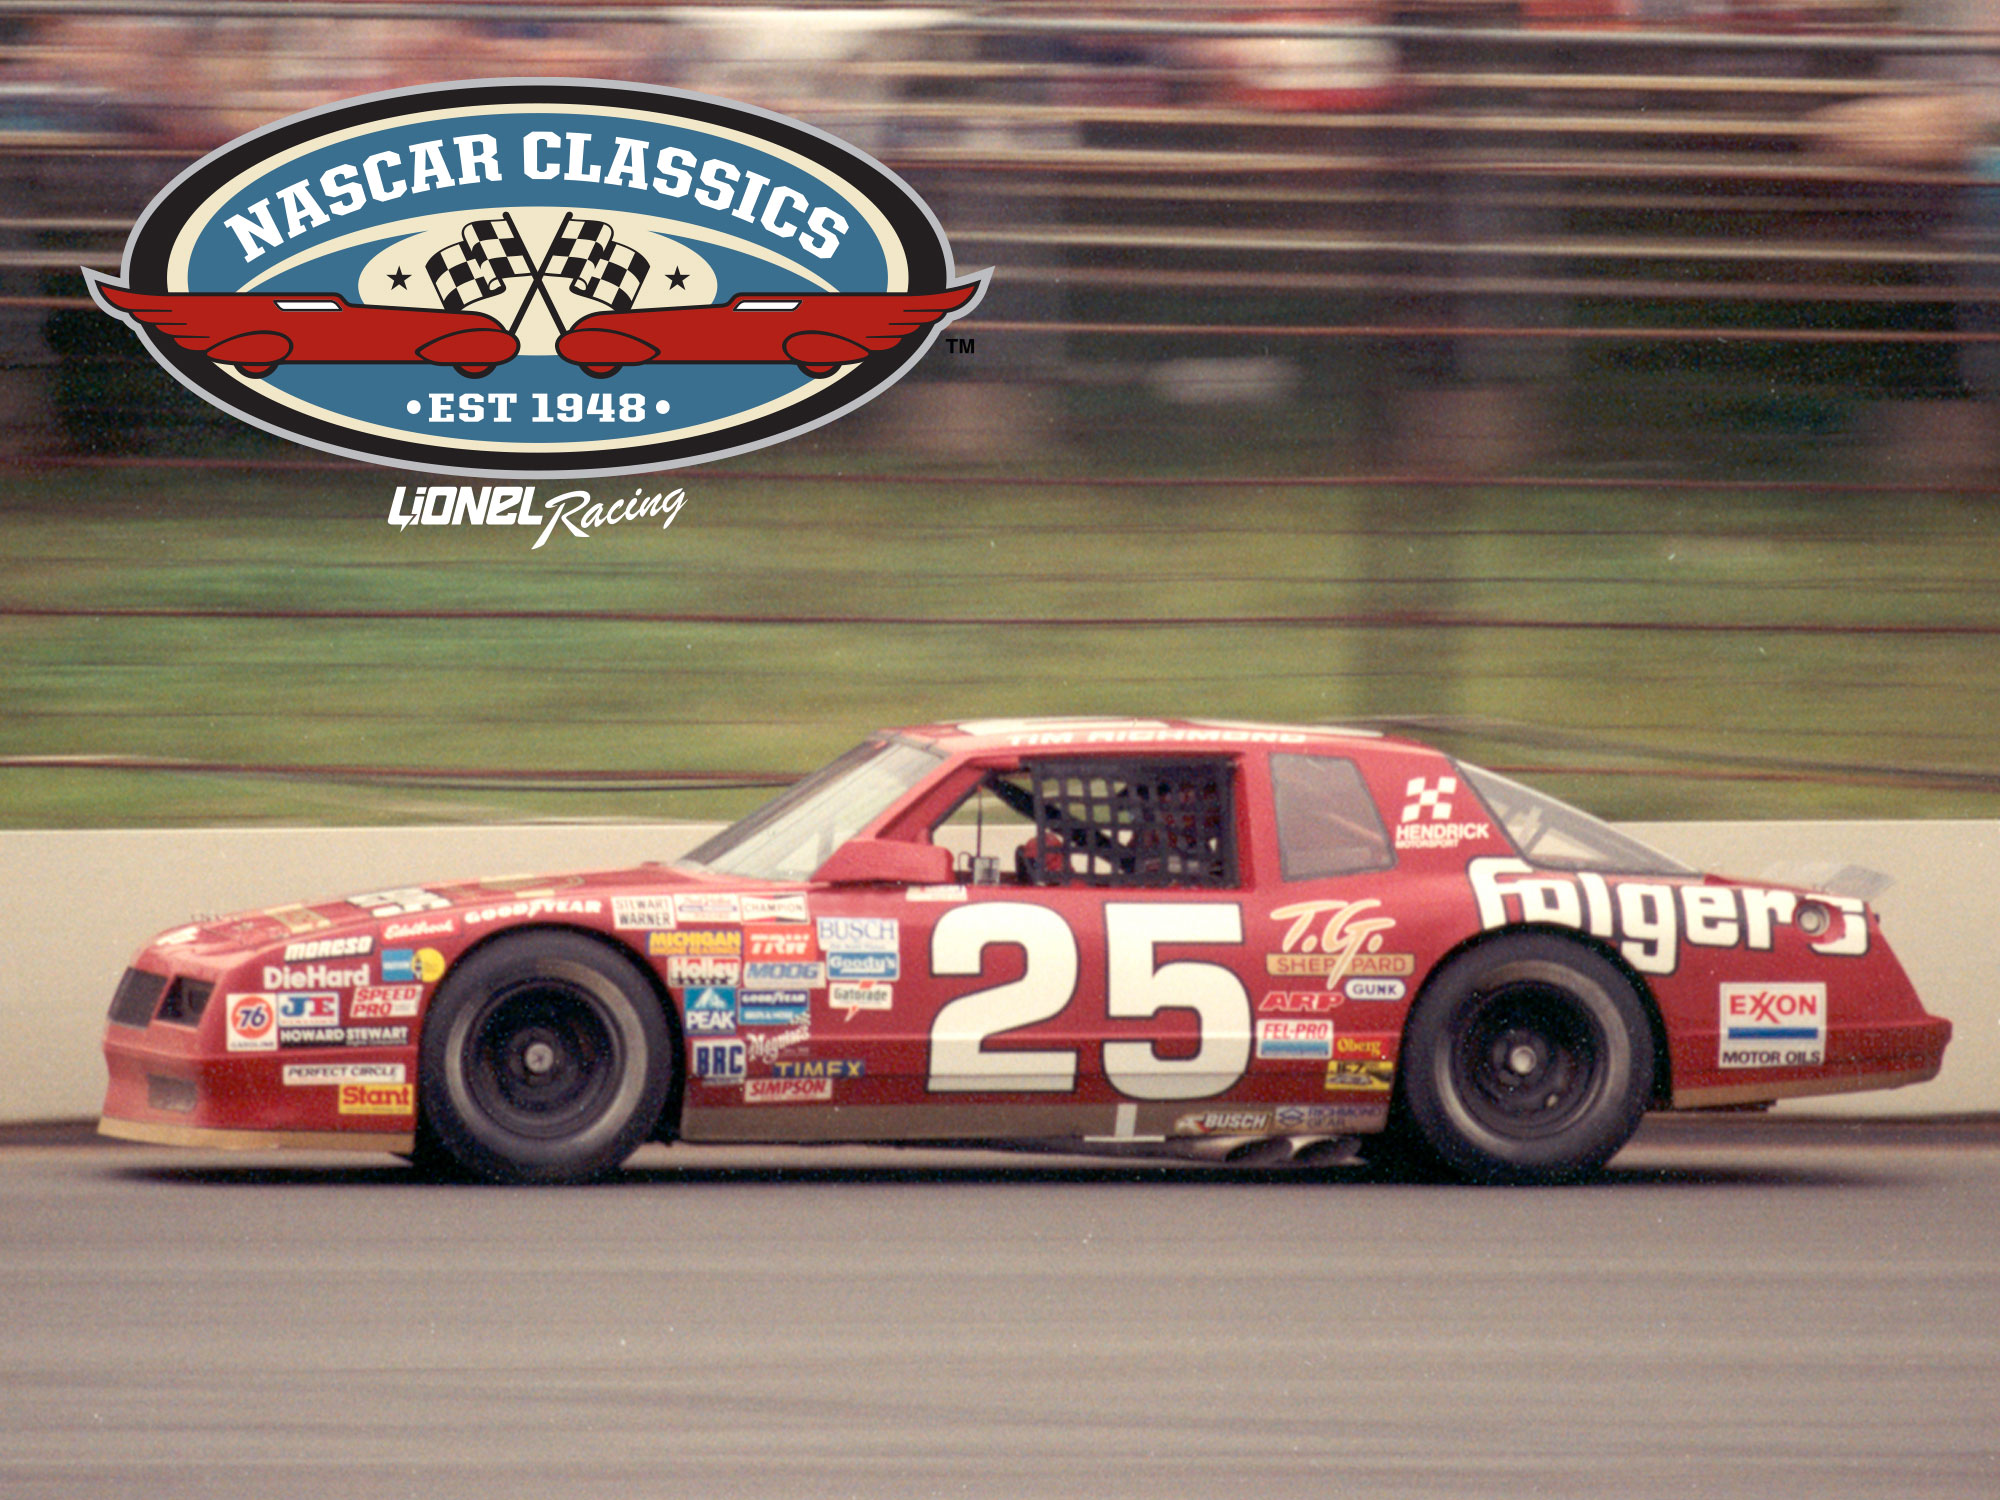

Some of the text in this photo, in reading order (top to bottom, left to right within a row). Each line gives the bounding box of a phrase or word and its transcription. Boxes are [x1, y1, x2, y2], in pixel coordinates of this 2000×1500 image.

[1009, 731, 1074, 746] TIM
[1396, 822, 1489, 840] HENDRICK
[464, 899, 602, 924] GOODYEAR
[744, 903, 803, 912] CHAMPION
[620, 911, 671, 926] WARNER
[650, 931, 741, 946] MICHIGAN
[819, 919, 896, 941] BUSCH
[750, 934, 811, 955] TRW
[1270, 898, 1397, 990] T.G.
[671, 957, 740, 981] Holley
[746, 963, 819, 979] MOOG
[829, 955, 896, 970] Goody's
[263, 964, 370, 990] DieHard
[356, 987, 417, 1002] SPEED
[834, 987, 888, 1001] Gatorade
[1352, 983, 1398, 996] GUNK
[281, 996, 335, 1017] JE
[353, 1003, 393, 1016] PRO
[926, 901, 1255, 1102] 25
[1258, 991, 1345, 1012] ARP
[1730, 991, 1817, 1024] EXXON
[239, 1006, 266, 1028] 76
[686, 1011, 736, 1030] PEAK
[280, 1027, 409, 1042] HOWARD STEWART
[1263, 1023, 1329, 1040] FEL-PRO
[1722, 1050, 1822, 1065] MOTOR OILS
[288, 1066, 398, 1077] PERFECT CIRCLE
[342, 1084, 411, 1106] Stant
[750, 1079, 827, 1096] SIMPSON
[1204, 1112, 1267, 1129] BUSCH
